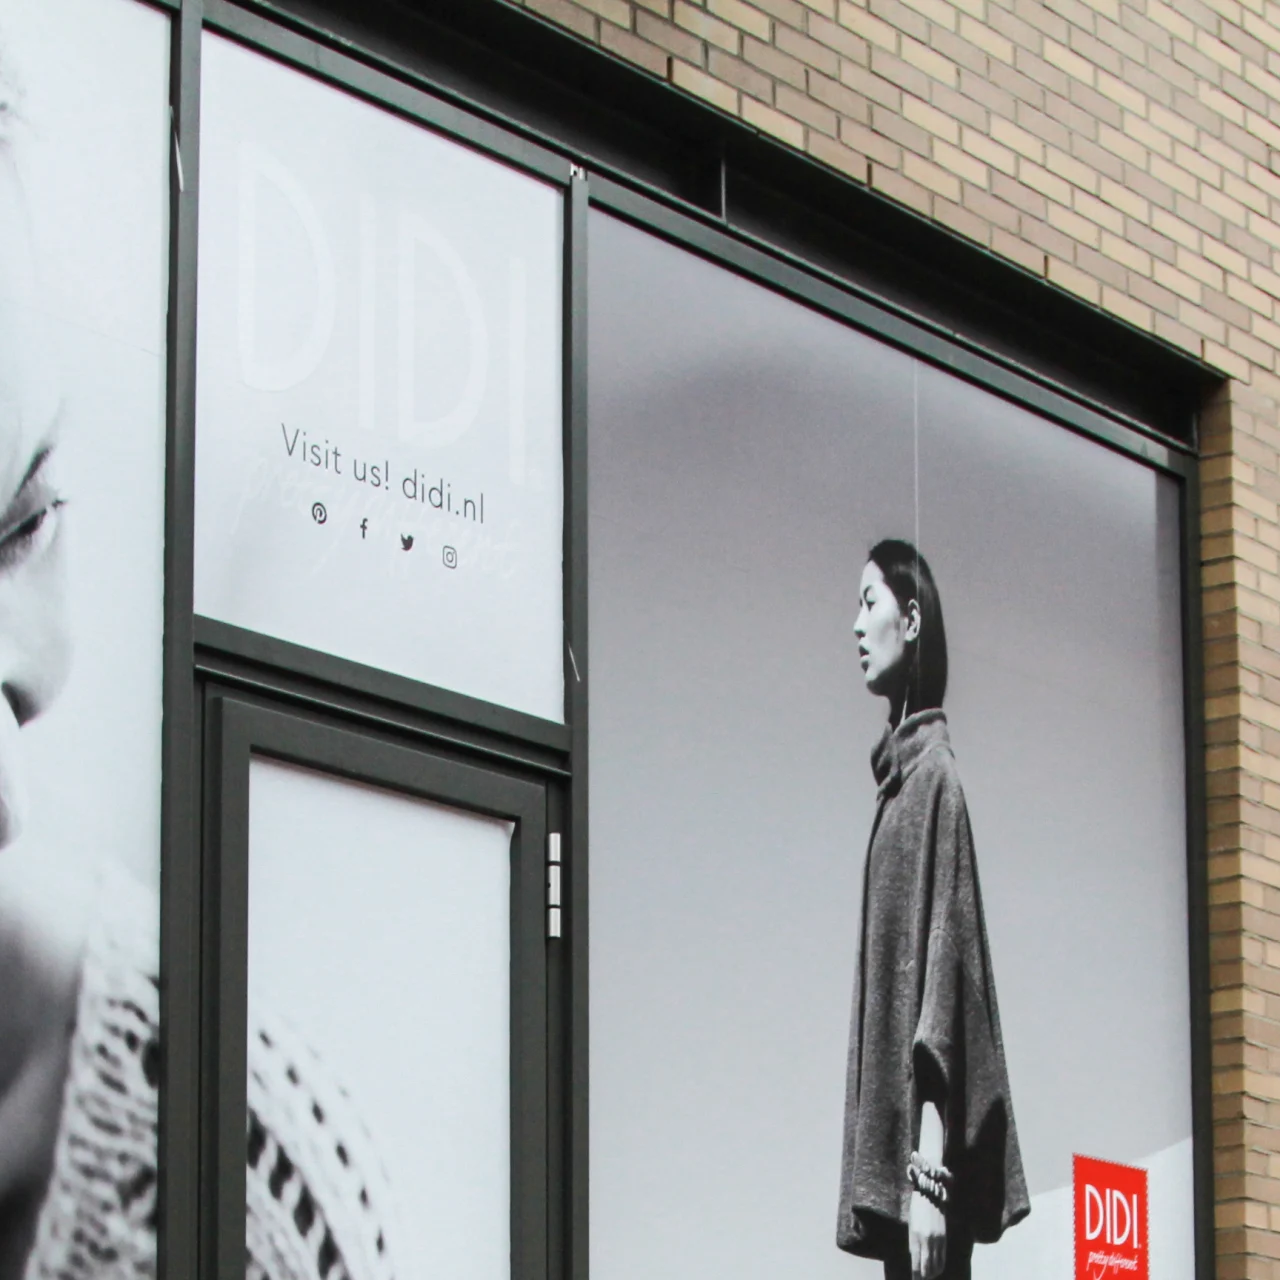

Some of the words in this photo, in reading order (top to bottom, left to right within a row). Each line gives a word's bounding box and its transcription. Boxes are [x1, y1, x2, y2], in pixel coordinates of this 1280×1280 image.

[237, 140, 527, 487] DIDI
[281, 422, 342, 475] Visit
[353, 458, 390, 491] us!
[401, 468, 484, 525] didi.nl
[1084, 1183, 1139, 1249] DIDI
